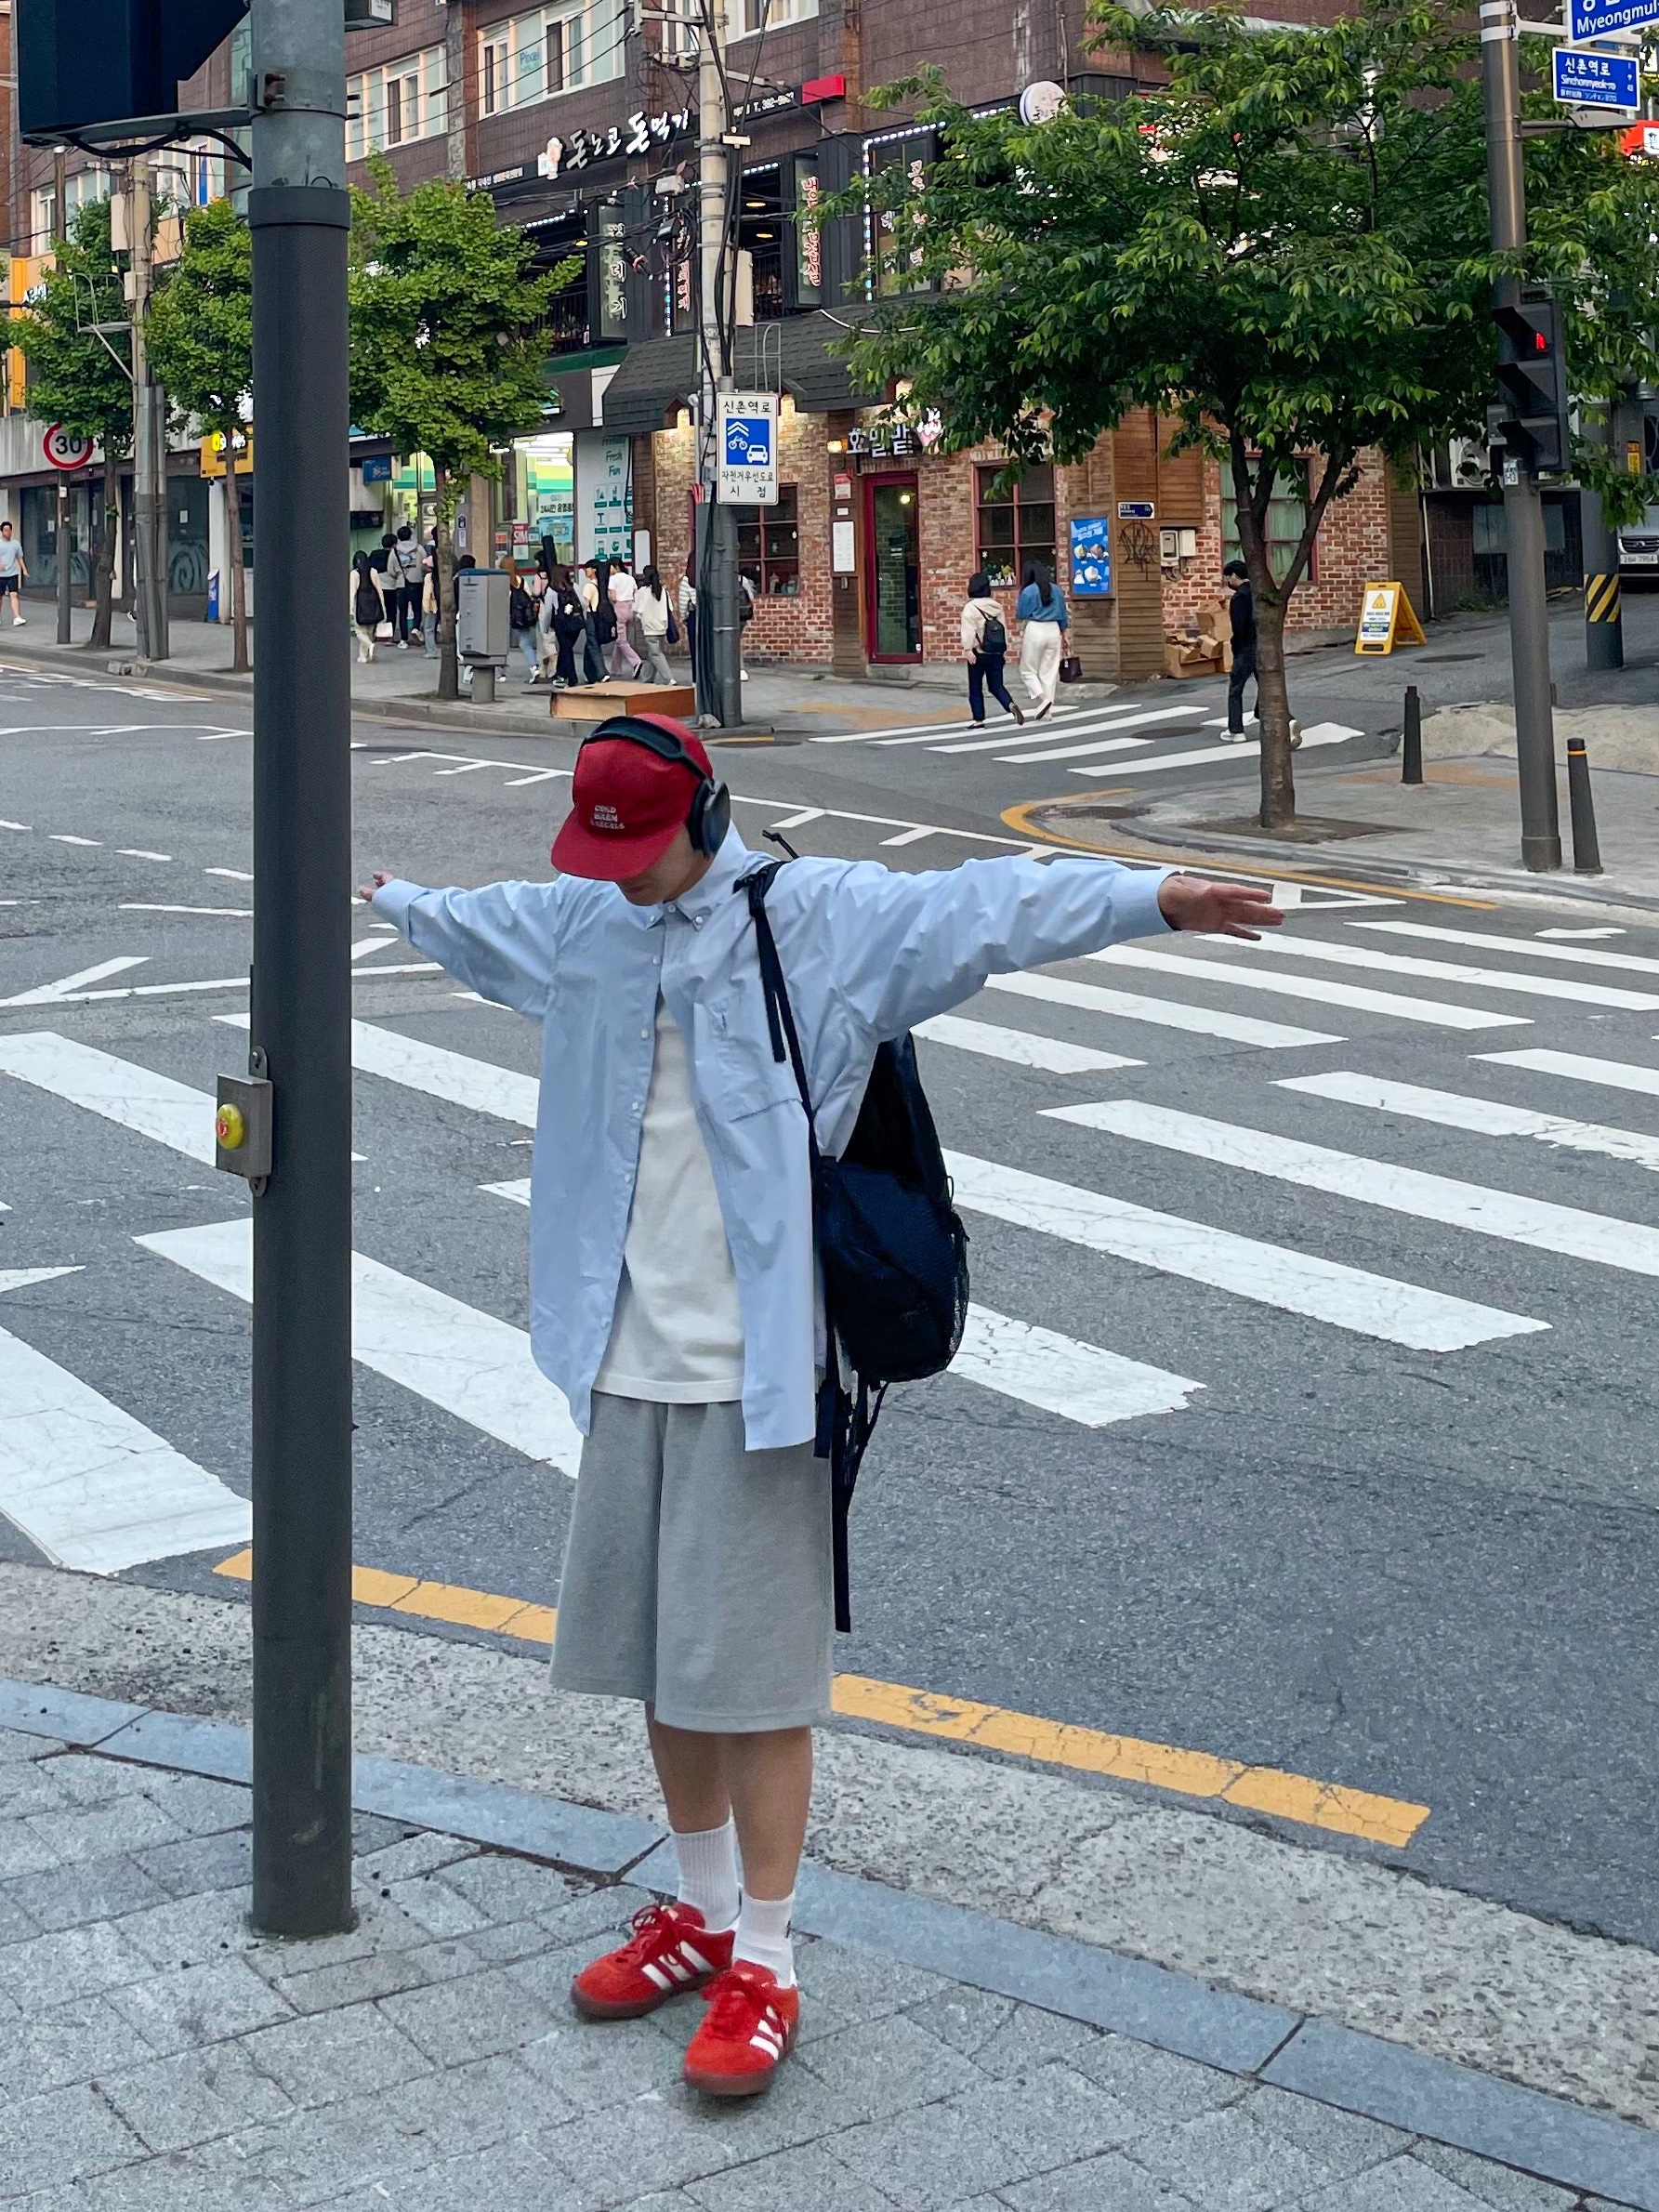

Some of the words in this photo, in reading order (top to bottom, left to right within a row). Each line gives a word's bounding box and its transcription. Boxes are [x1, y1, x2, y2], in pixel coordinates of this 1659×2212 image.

[1564, 57, 1611, 76] 신촌역로
[724, 400, 771, 415] 신촌역로
[56, 435, 82, 454] 30
[846, 423, 914, 458] 호밀밭
[721, 470, 774, 483] 자전거우선도로
[731, 485, 740, 497] 시
[757, 486, 767, 498] 점
